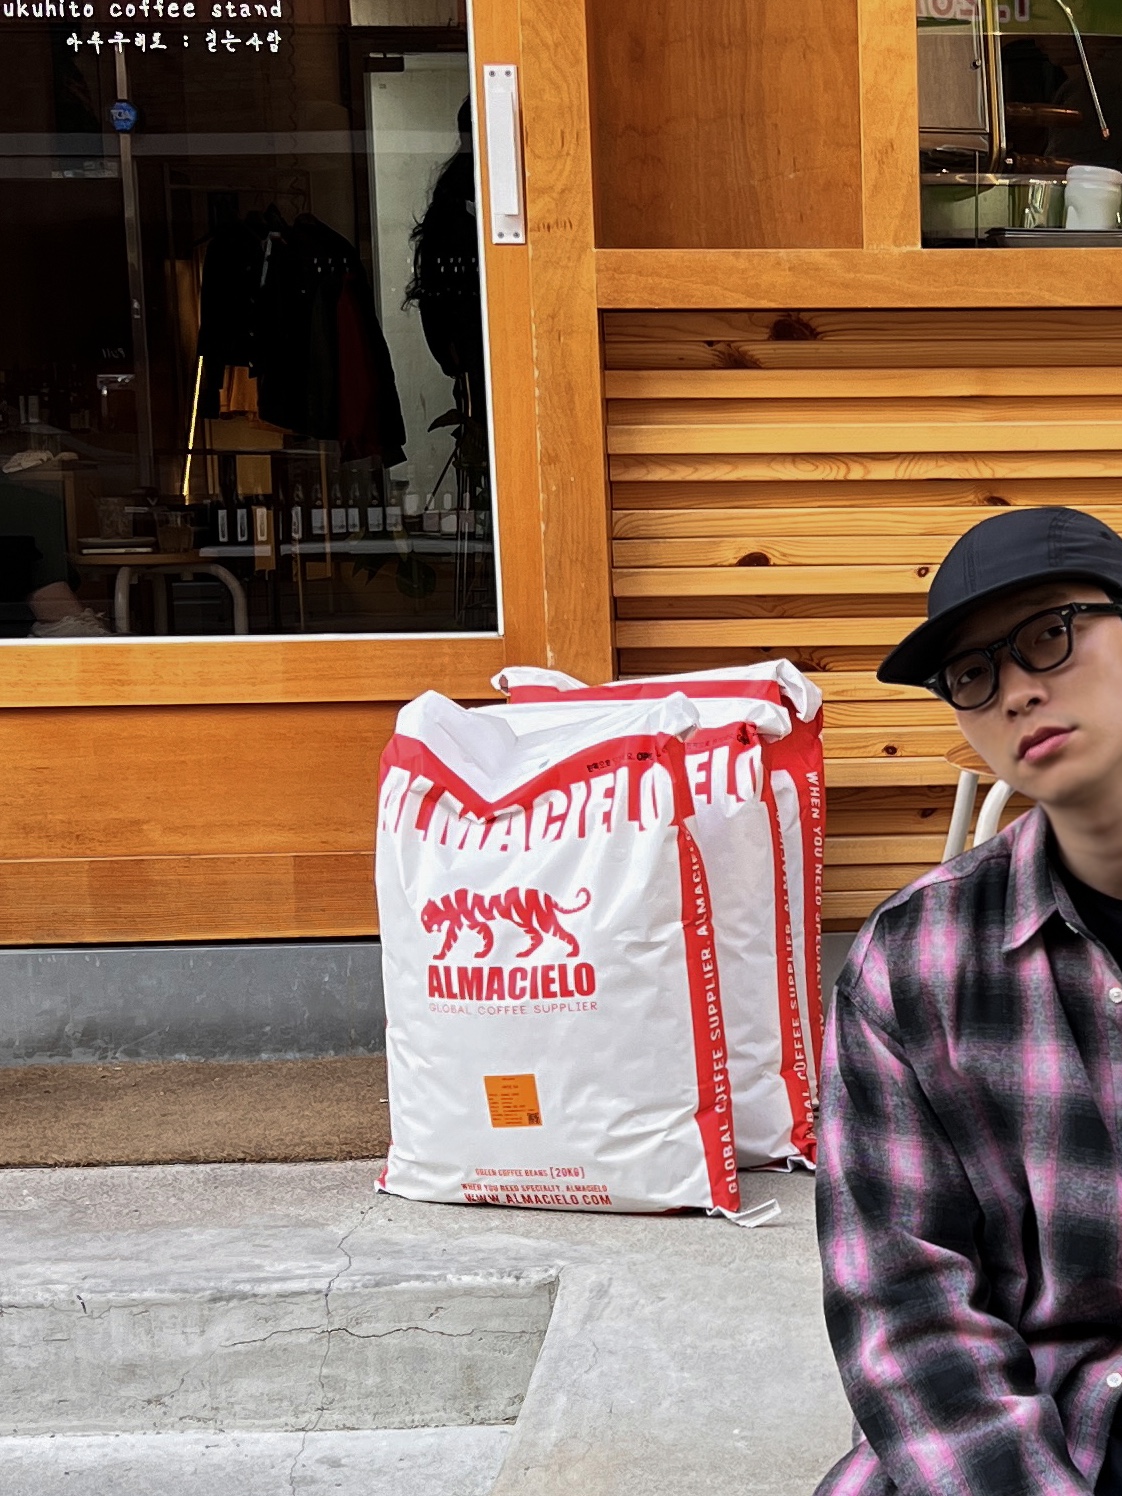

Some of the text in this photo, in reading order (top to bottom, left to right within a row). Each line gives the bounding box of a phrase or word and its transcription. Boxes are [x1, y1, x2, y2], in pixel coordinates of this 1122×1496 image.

[109, 0, 196, 18] coffee
[211, 0, 282, 18] stand
[806, 771, 821, 819] WHEN
[812, 826, 823, 858] YOU
[428, 962, 597, 1001] ALMACIELO
[429, 1002, 598, 1016] GLOBAL COFFEE SUPPLIER
[712, 1046, 728, 1114] COFFEE
[719, 1119, 738, 1194] GLOBAL
